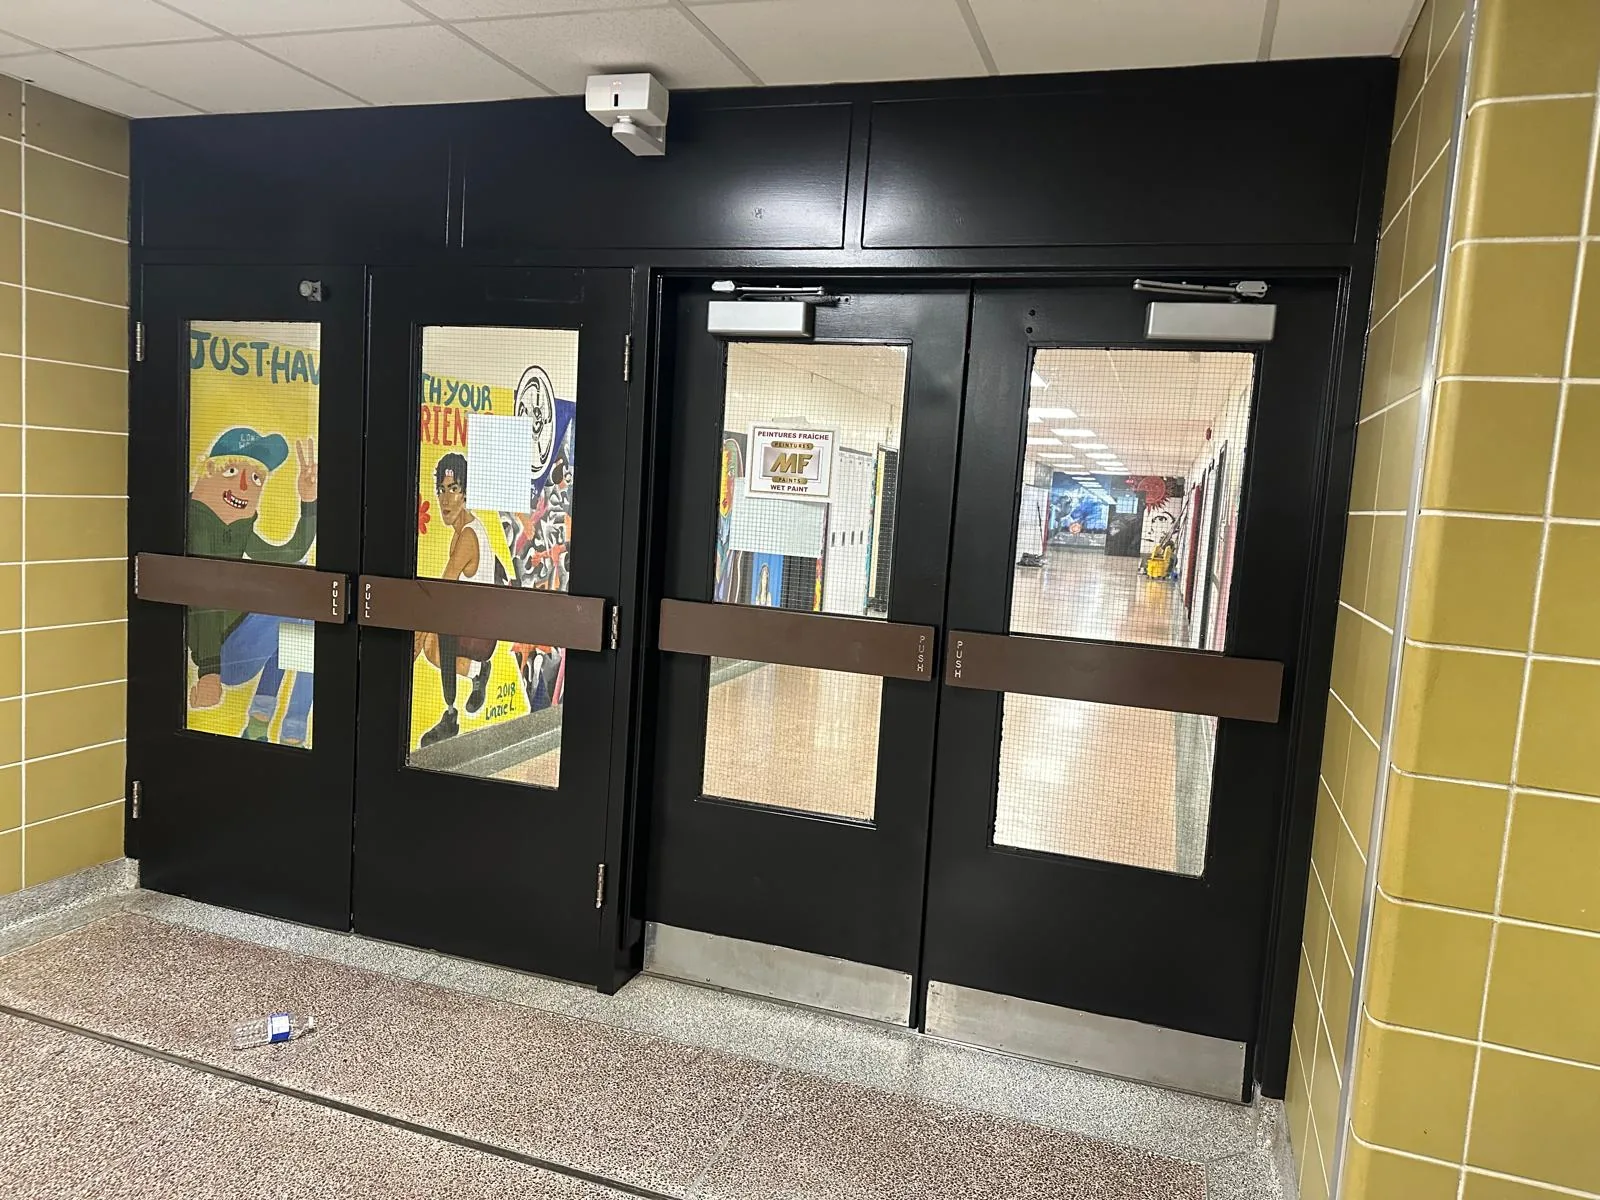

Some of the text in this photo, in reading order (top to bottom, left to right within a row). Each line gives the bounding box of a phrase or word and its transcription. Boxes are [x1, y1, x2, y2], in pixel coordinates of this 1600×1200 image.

[191, 329, 269, 376] JUST
[444, 379, 492, 411] YOUR
[421, 405, 494, 447] RIEN
[758, 431, 797, 439] PEINTURES
[770, 452, 813, 474] MF
[917, 635, 925, 672] PUSH
[954, 640, 963, 678] PUSH
[496, 682, 516, 699] 2018
